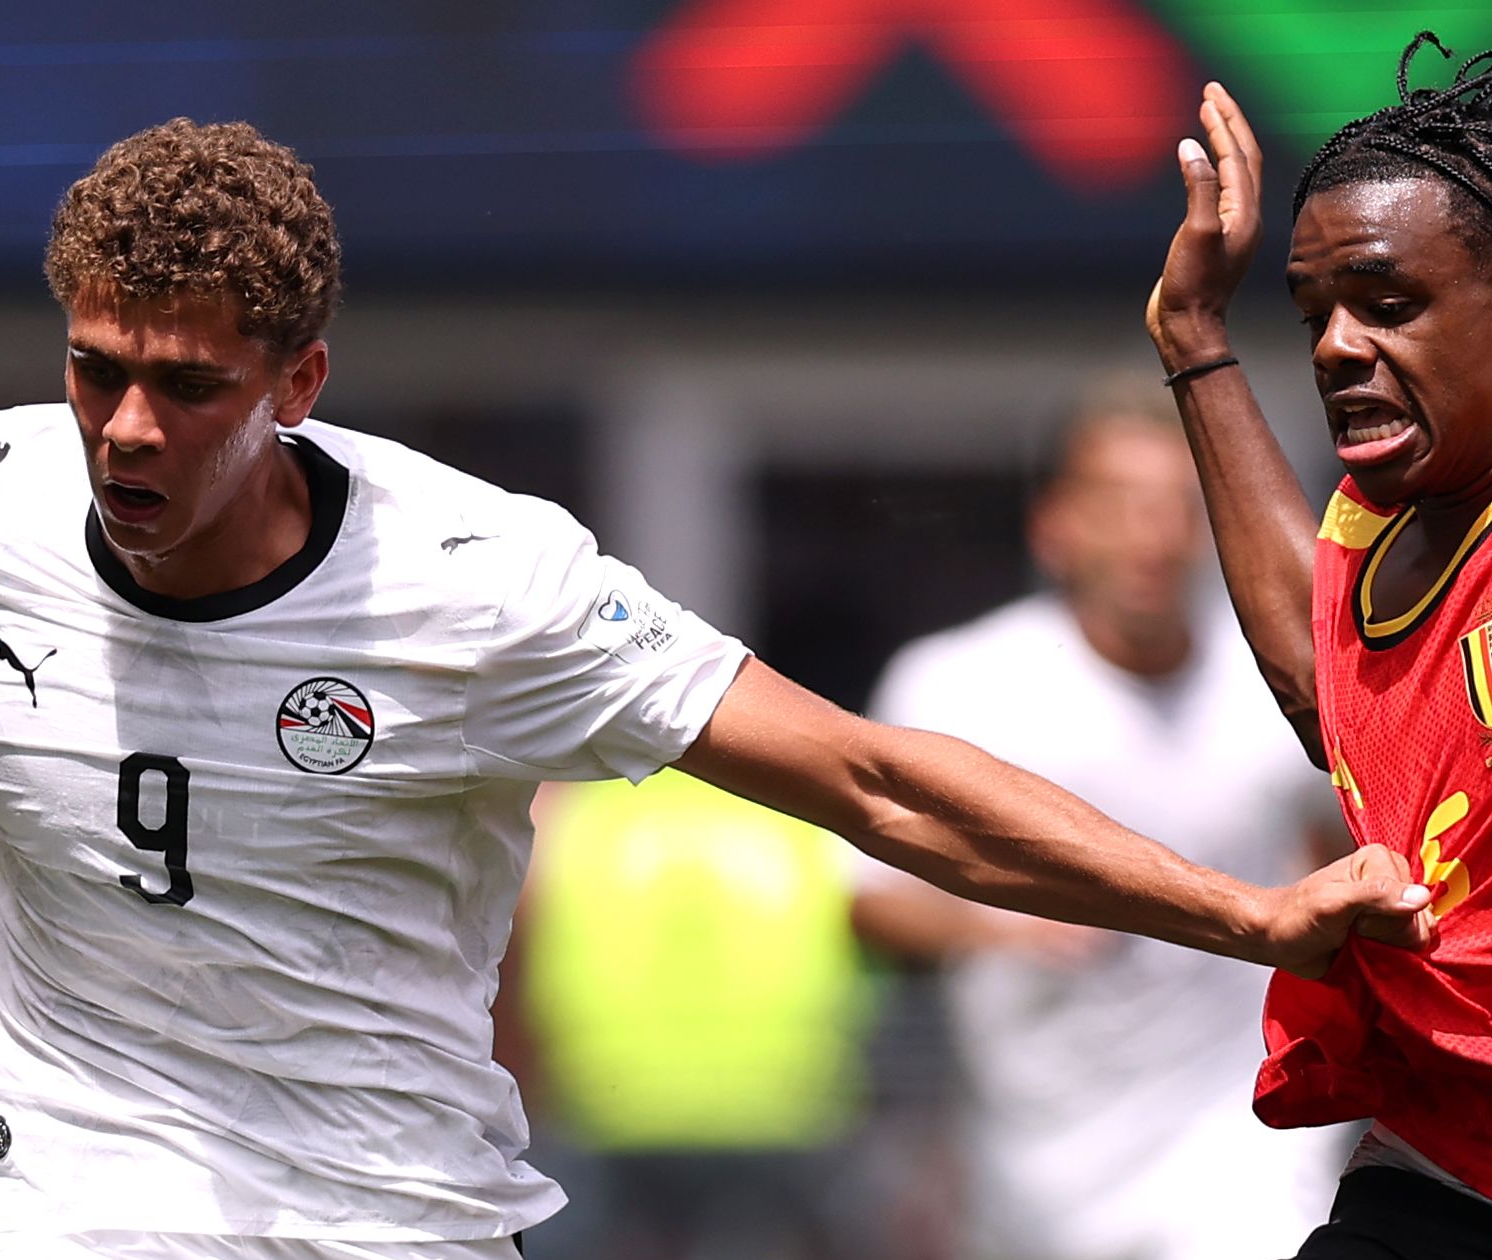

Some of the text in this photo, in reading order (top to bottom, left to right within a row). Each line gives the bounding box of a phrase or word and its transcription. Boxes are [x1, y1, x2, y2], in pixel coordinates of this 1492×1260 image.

[634, 611, 667, 651] PEACE
[650, 632, 673, 652] FIFA
[299, 754, 346, 767] EGYPTIAN FA
[117, 752, 194, 907] 9
